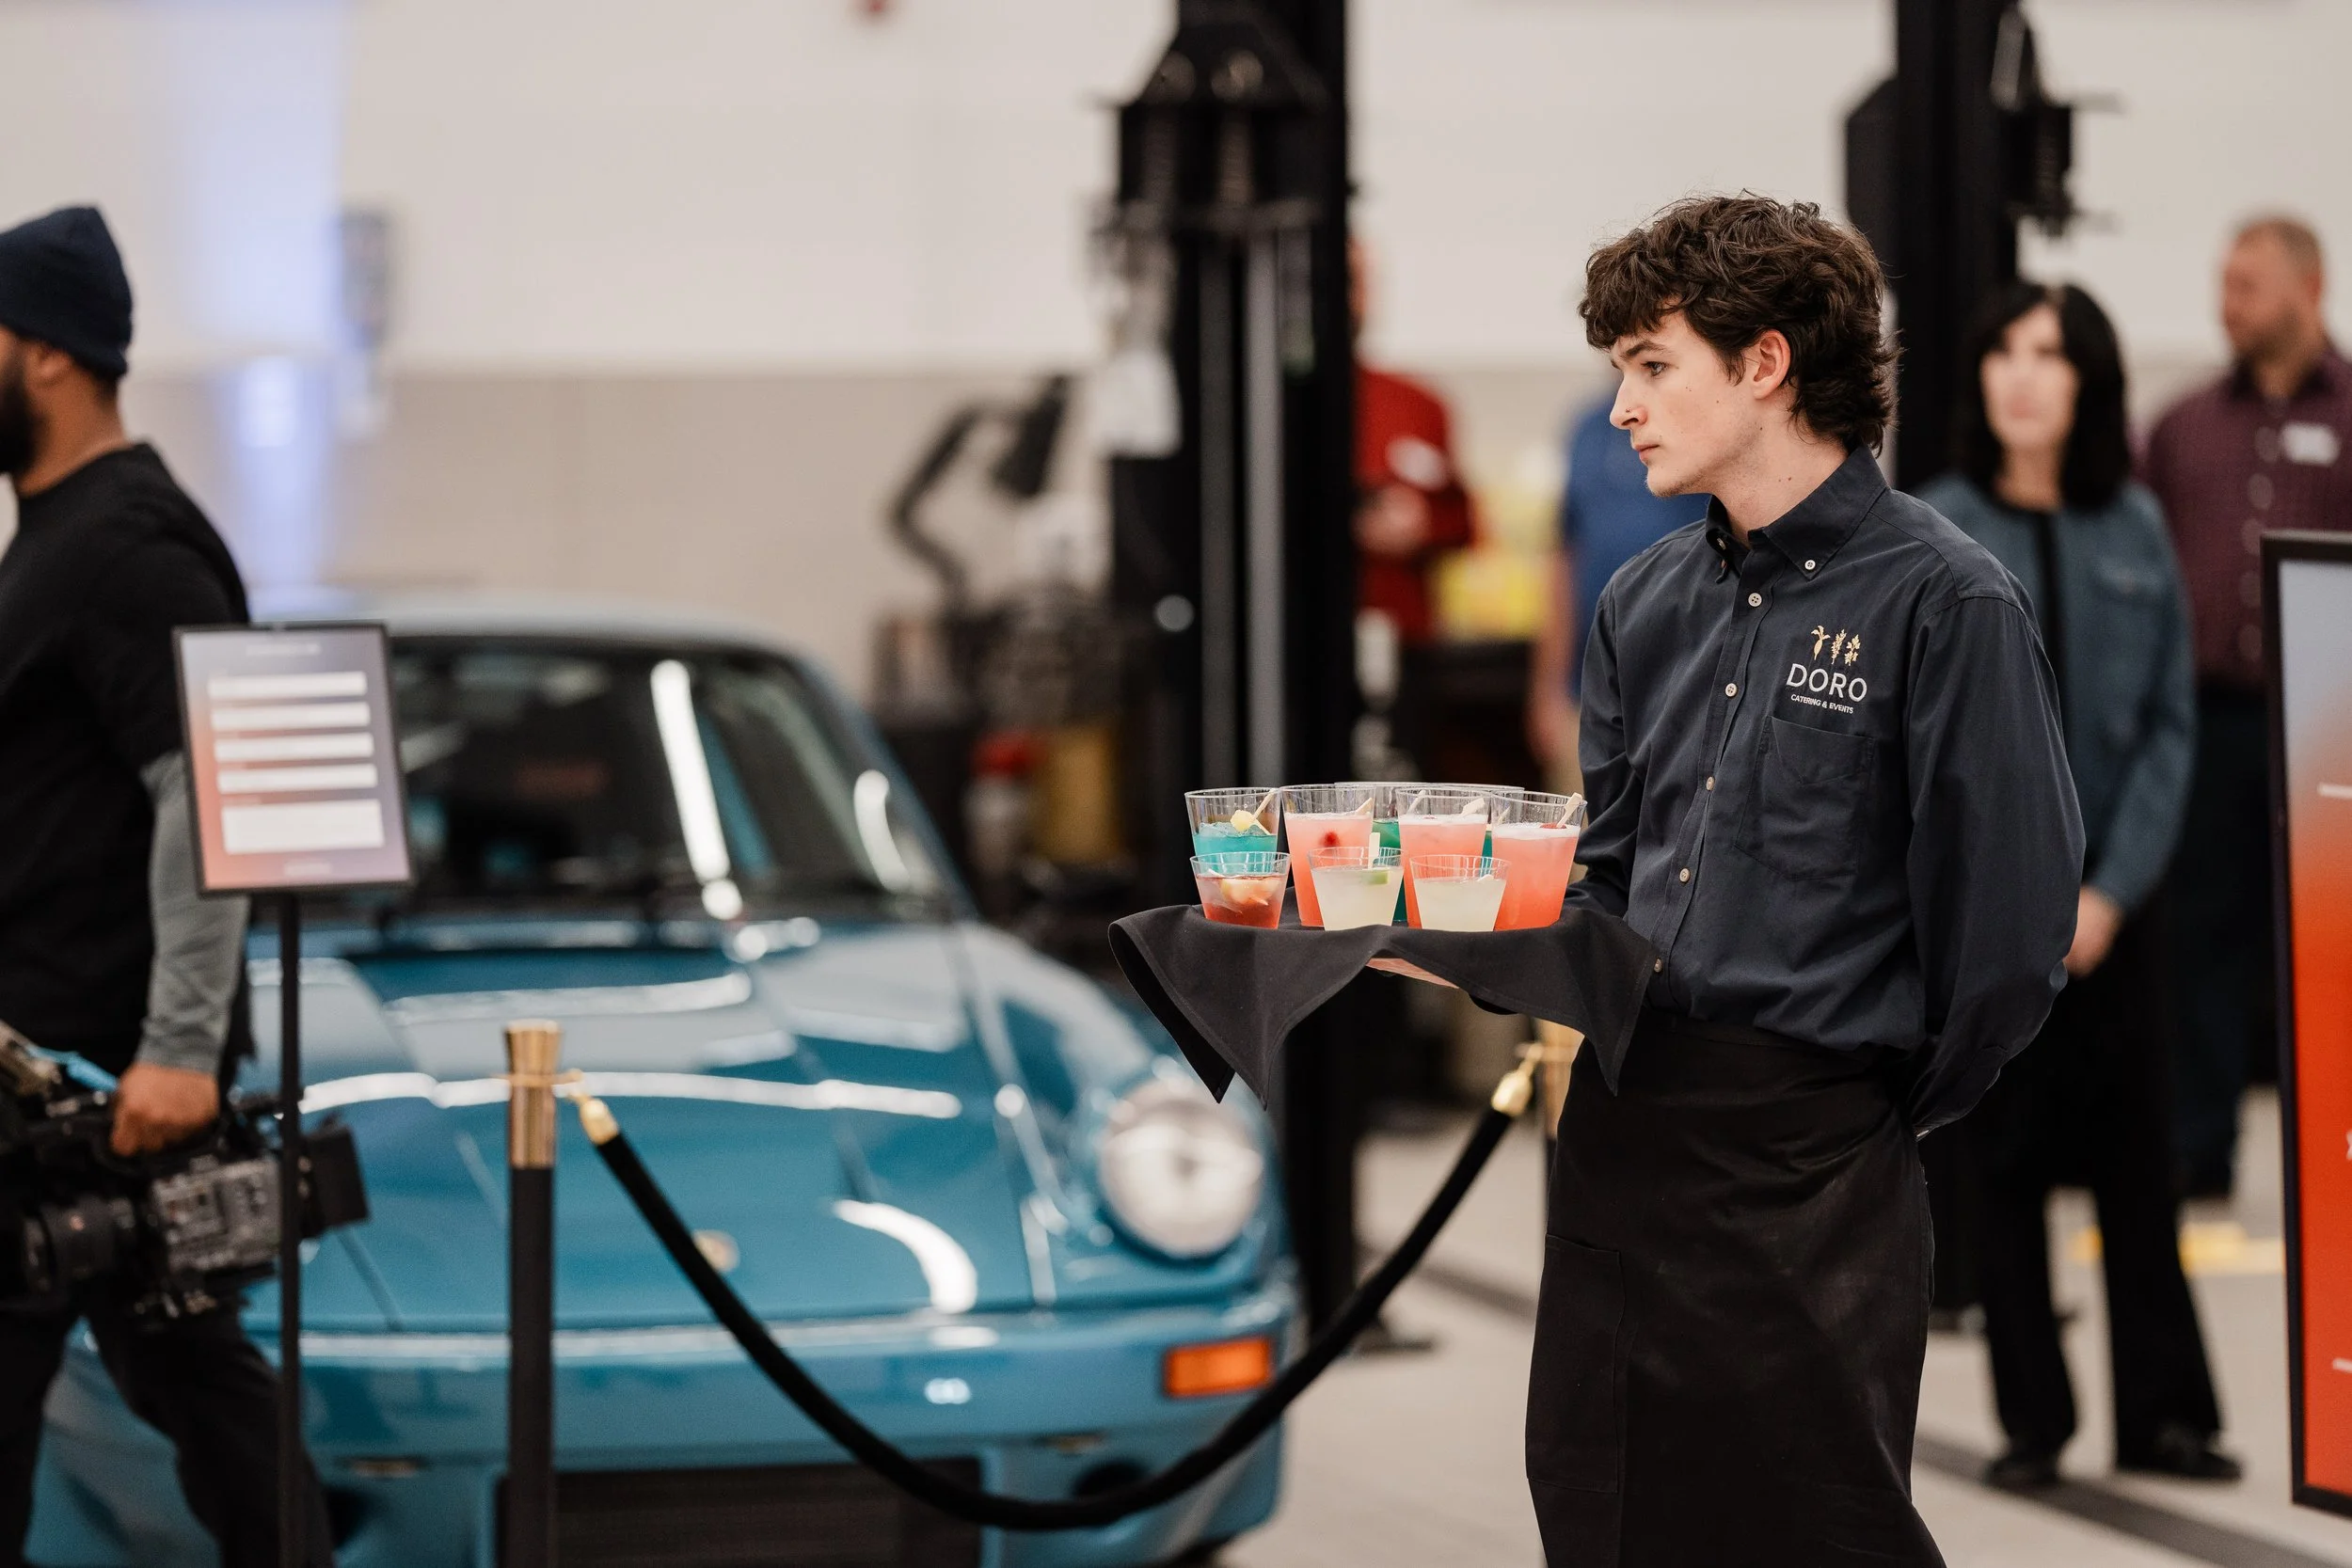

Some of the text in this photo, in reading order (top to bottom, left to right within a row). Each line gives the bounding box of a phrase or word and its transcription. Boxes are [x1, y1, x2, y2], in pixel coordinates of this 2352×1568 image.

[1786, 663, 1867, 703] DORO
[1790, 693, 1854, 714] CATERING & EVENTS
